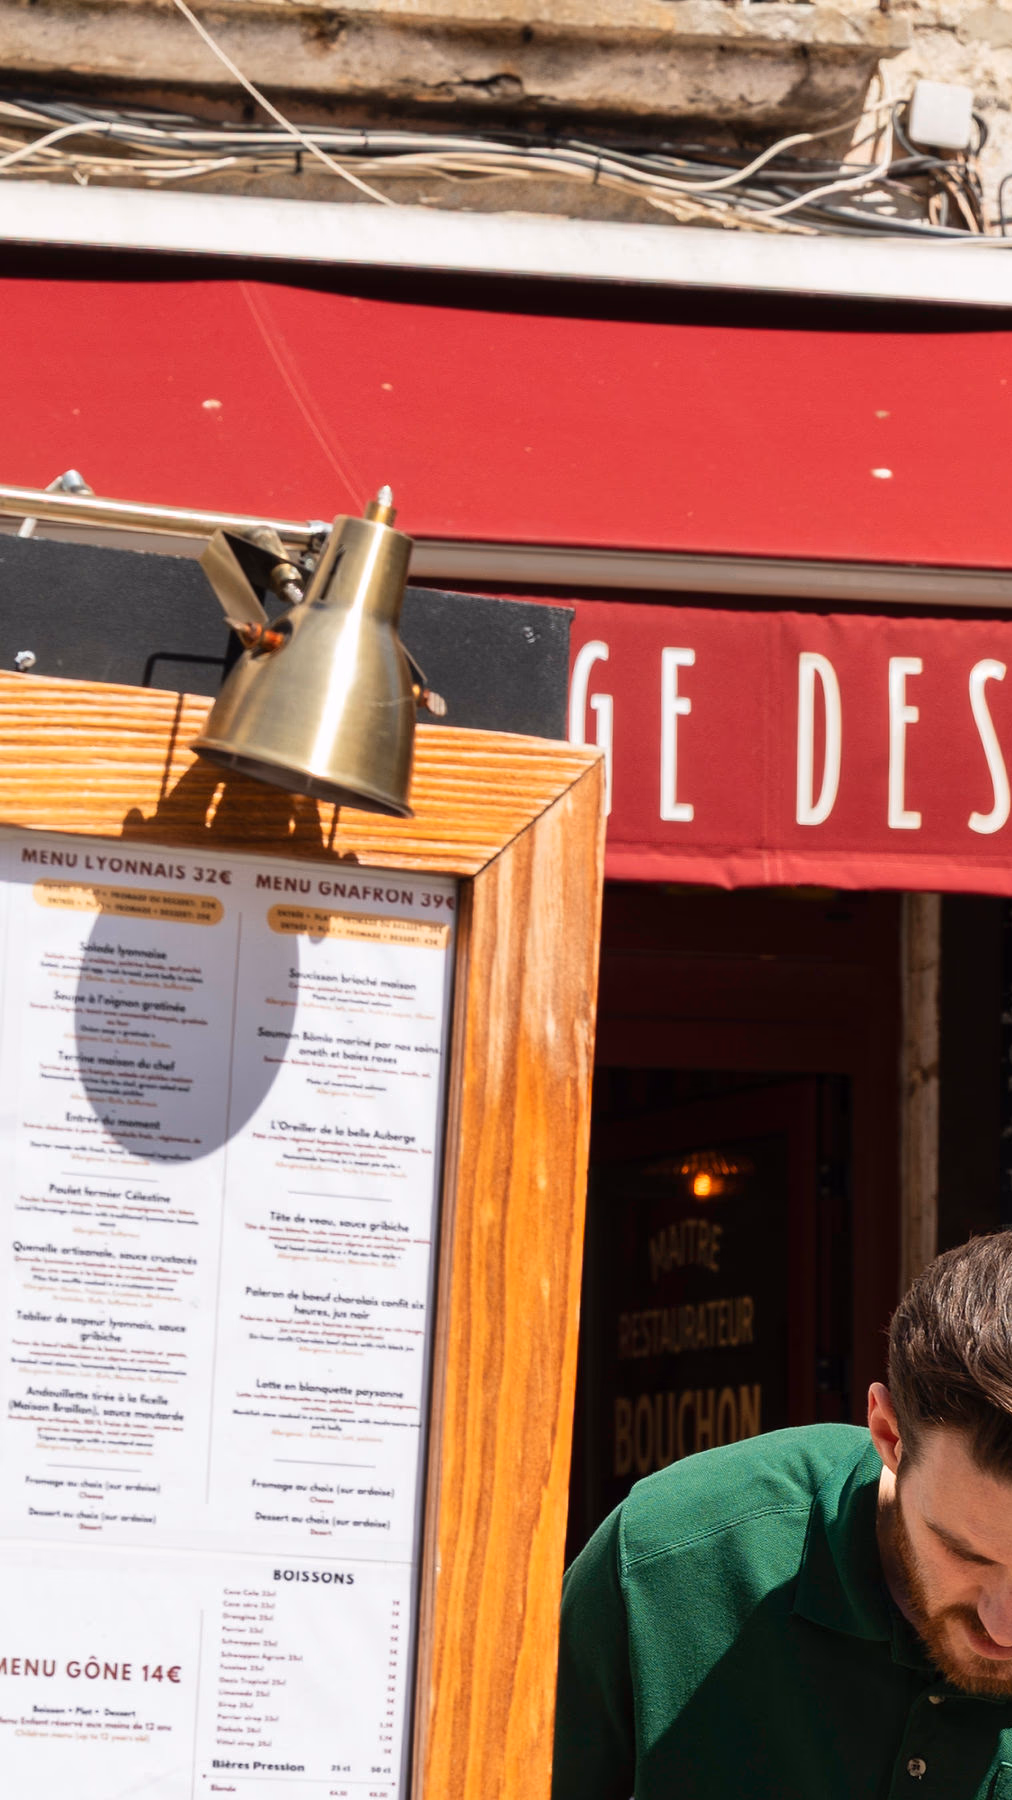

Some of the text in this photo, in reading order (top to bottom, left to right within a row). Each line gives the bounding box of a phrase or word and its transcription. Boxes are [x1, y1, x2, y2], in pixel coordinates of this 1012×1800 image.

[796, 652, 1011, 835] DES
[21, 848, 233, 885] MENU LYONNAIS 32€
[256, 874, 456, 910] MENU GNAFRON 39€
[373, 1129, 416, 1145] Auberge
[270, 1210, 290, 1222] Tête
[294, 1213, 305, 1223] de
[340, 1220, 366, 1229] sauce
[370, 1220, 409, 1233] gribiche
[245, 1286, 285, 1299] Paleron
[288, 1289, 299, 1300] de
[333, 1293, 378, 1306] charolais
[381, 1298, 408, 1309] confit
[411, 1300, 425, 1310] six
[294, 1305, 370, 1320] heures, jus noir
[256, 1379, 404, 1399] Lotte en blanquette paysanne
[613, 1383, 762, 1478] BOUCHON
[251, 1479, 293, 1492] Fromage
[296, 1484, 307, 1492] au
[310, 1483, 334, 1493] choix
[255, 1511, 289, 1523] Dessert
[292, 1516, 302, 1524] au
[306, 1515, 329, 1525] choix
[273, 1569, 355, 1585] BOISSONS
[67, 1656, 132, 1681] GÔNE
[142, 1664, 182, 1684] 14€
[212, 1760, 305, 1773] Bières Pression
